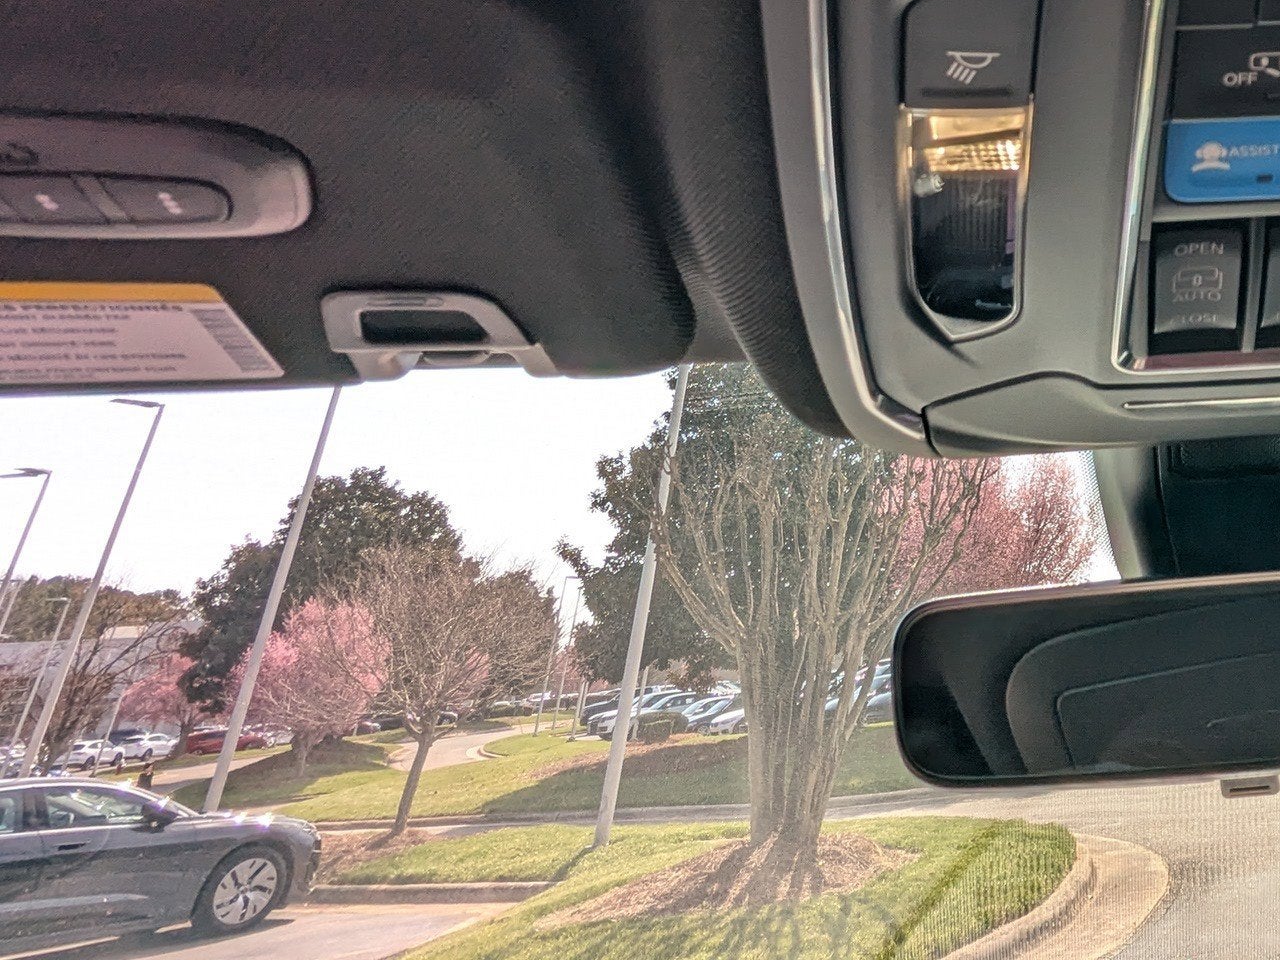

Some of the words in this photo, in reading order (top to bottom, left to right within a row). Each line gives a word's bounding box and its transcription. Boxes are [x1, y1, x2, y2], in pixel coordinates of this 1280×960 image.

[1222, 72, 1258, 87] OFF
[1174, 241, 1225, 257] OPEN
[1171, 290, 1222, 304] AUTO
